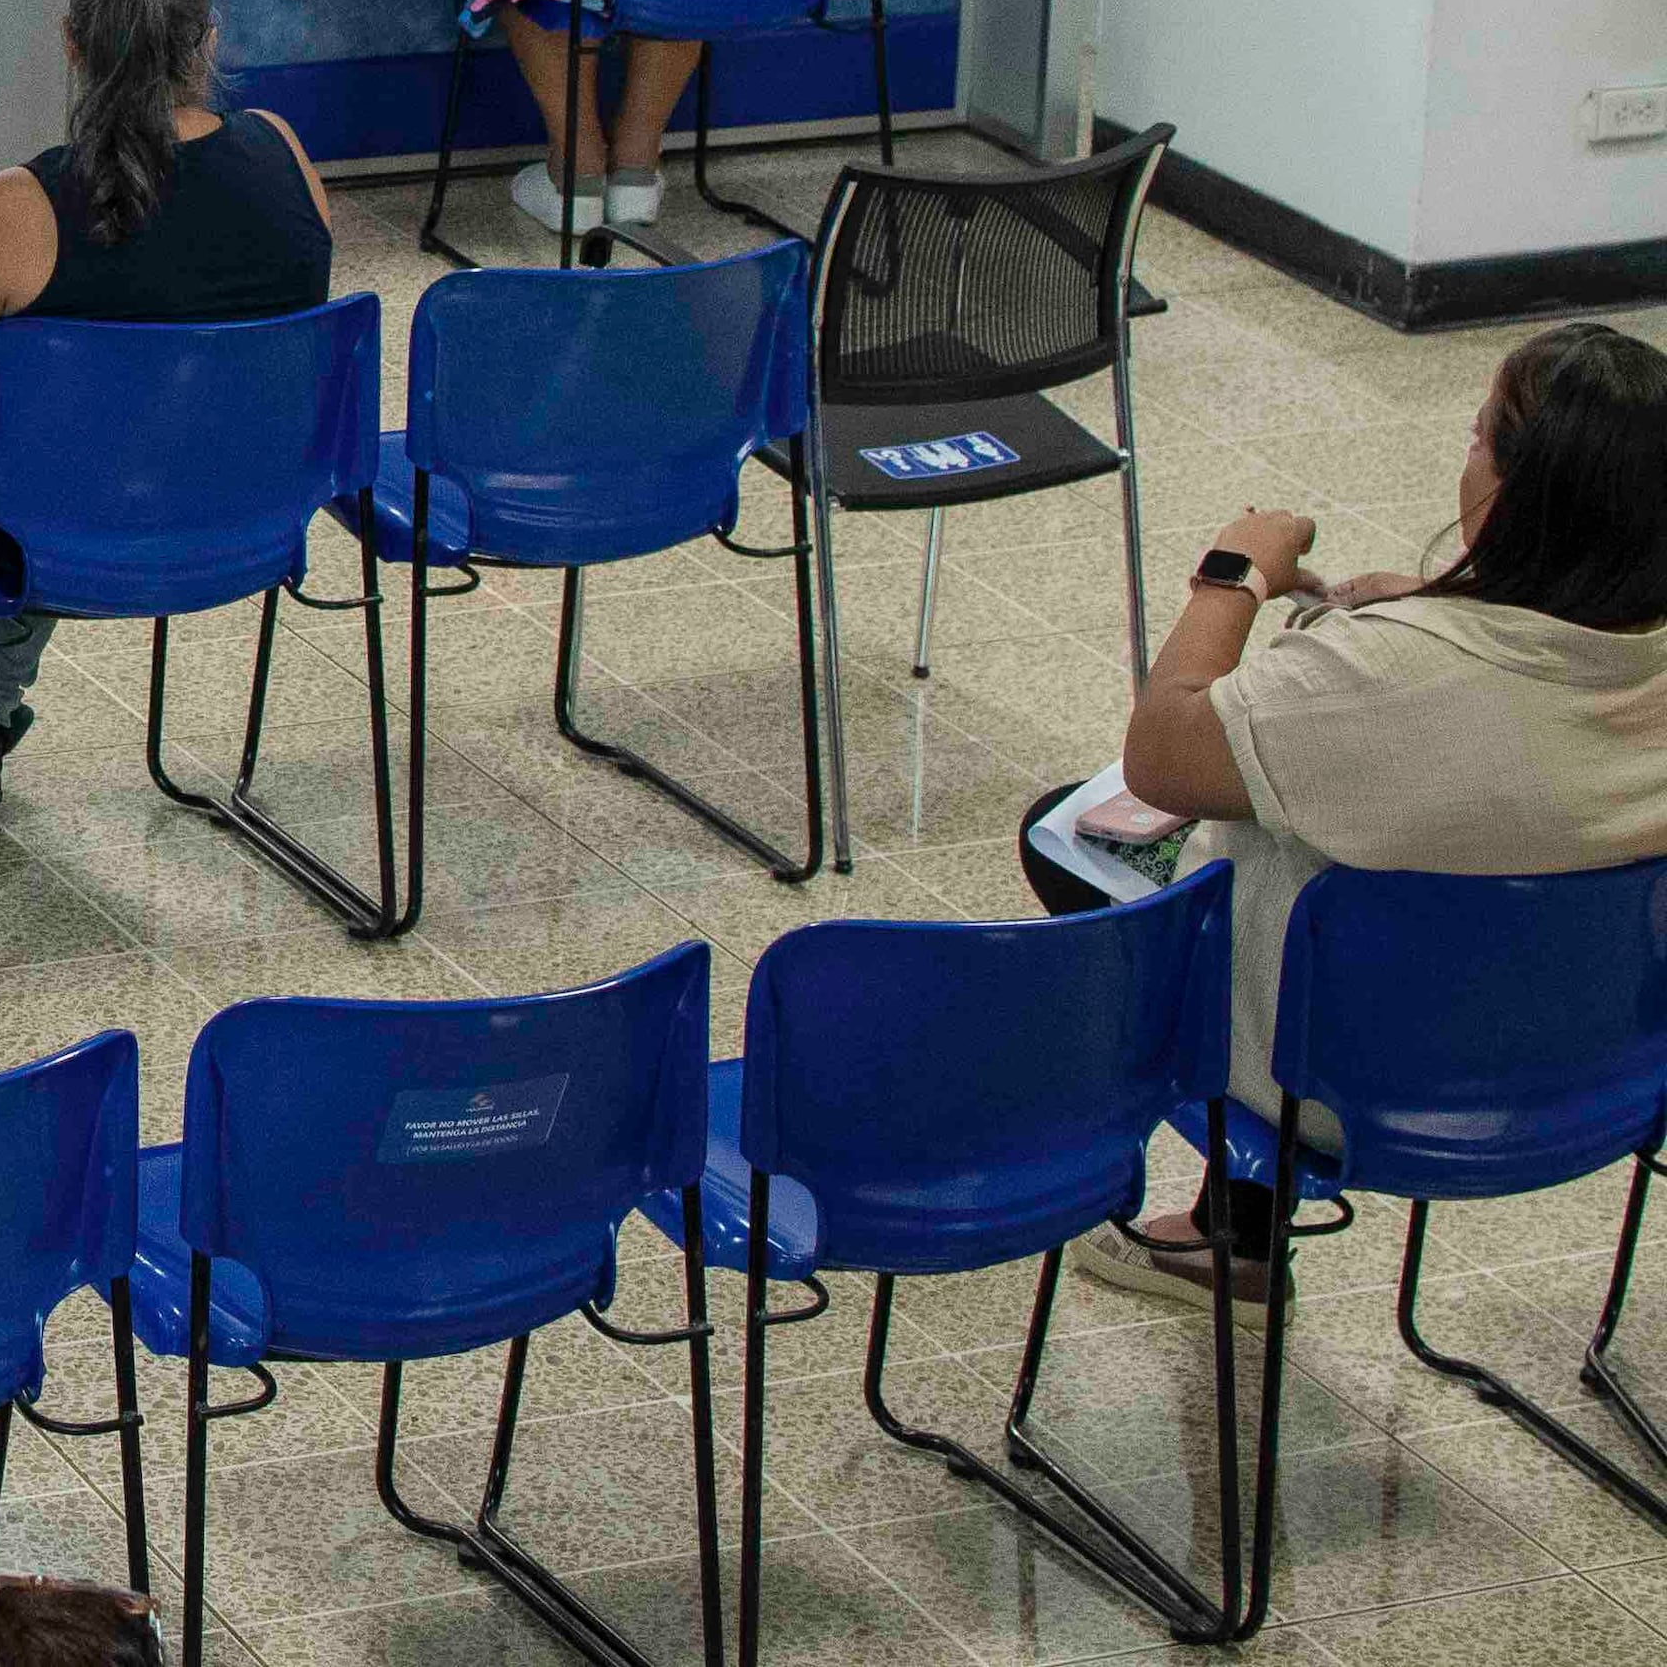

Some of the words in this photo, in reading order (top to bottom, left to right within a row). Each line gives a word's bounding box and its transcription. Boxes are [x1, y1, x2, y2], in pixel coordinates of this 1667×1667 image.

[404, 1121, 436, 1130] FAVOR
[439, 1120, 454, 1128] NO
[456, 1116, 490, 1127] MOVER
[412, 1128, 467, 1139] MANTENGA
[468, 1126, 479, 1135] LA
